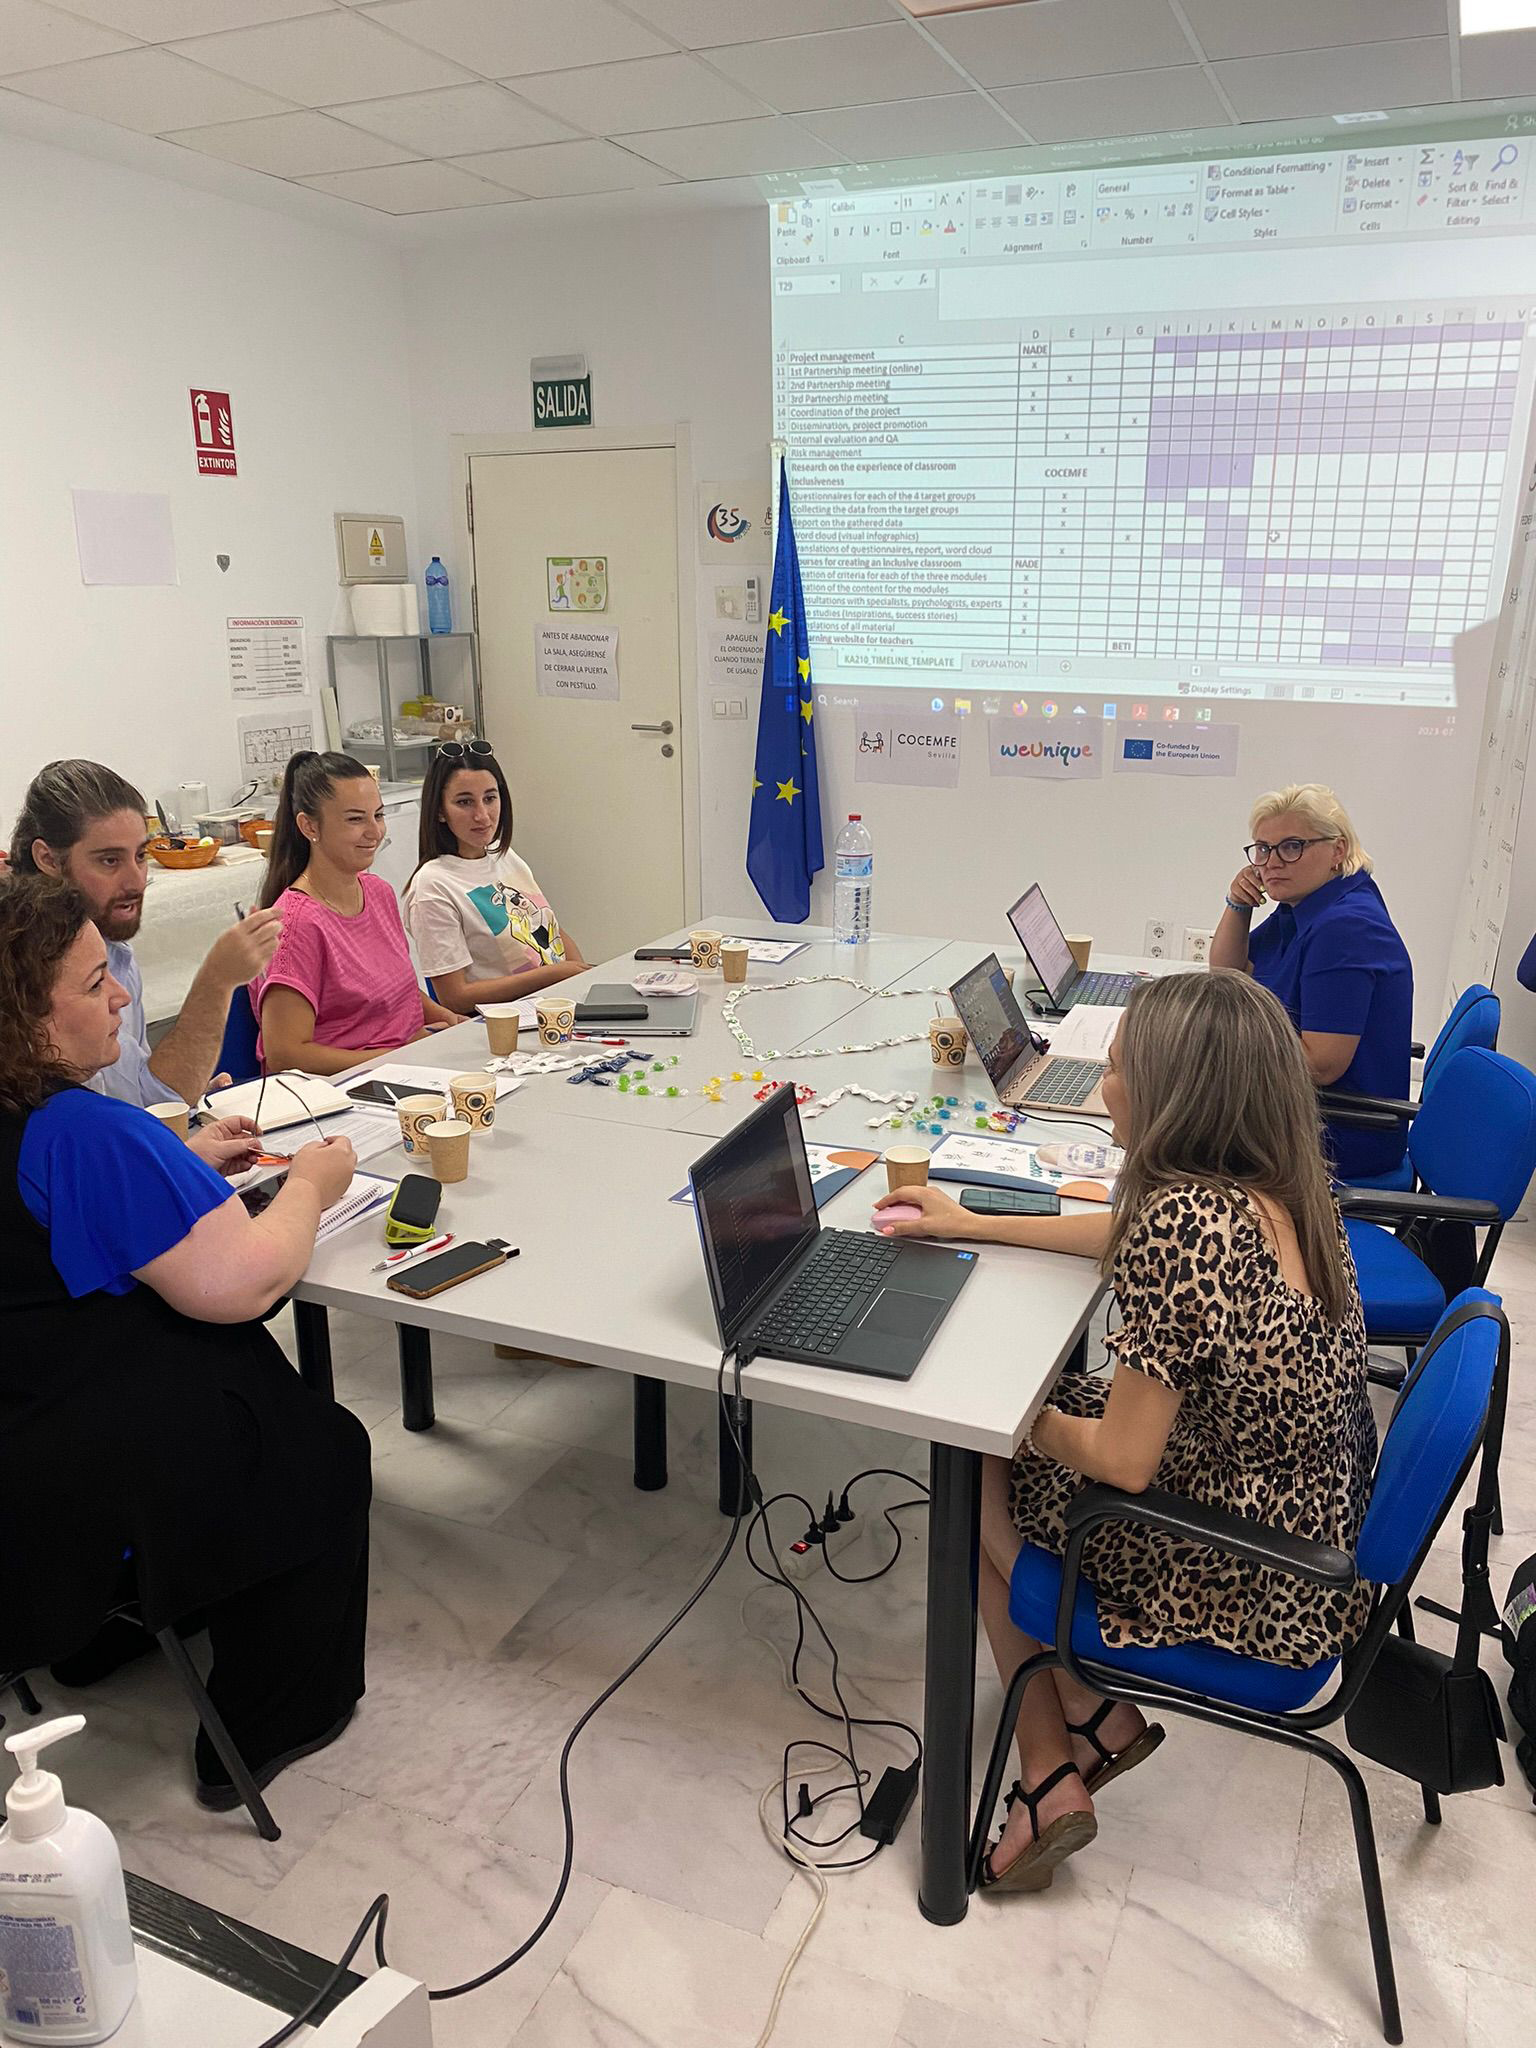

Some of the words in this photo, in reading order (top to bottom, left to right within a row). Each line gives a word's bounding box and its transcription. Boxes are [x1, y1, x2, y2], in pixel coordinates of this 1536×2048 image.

[1364, 157, 1389, 166] Insert
[1224, 165, 1274, 177] Conditional
[1276, 162, 1325, 173] Formatting
[1099, 182, 1129, 193] General
[1362, 179, 1390, 188] Delete
[1448, 182, 1466, 193] Sort
[1485, 180, 1506, 190] Find
[1222, 189, 1252, 198] Format
[1255, 188, 1264, 196] as
[1267, 185, 1288, 195] Table
[1360, 200, 1392, 210] Format
[1447, 198, 1469, 208] Filter
[1482, 195, 1510, 205] Select
[832, 202, 855, 212] Calibri
[1220, 210, 1236, 219] Cell
[1238, 208, 1263, 219] Styles
[1447, 216, 1480, 226] Editing
[1360, 222, 1380, 231] Cells
[777, 228, 796, 236] Paste
[1254, 228, 1277, 238] Styles
[1121, 236, 1153, 245] Number
[1003, 242, 1043, 252] Alignment
[883, 251, 900, 259] Font
[776, 256, 810, 266] Clipboard
[779, 282, 792, 291] T29
[1022, 345, 1048, 355] NADE
[790, 354, 818, 364] Project
[820, 352, 874, 363] management
[791, 368, 801, 376] 1st
[804, 366, 850, 376] Partnership
[853, 365, 887, 376] meeting
[889, 364, 923, 375] (online)
[791, 382, 804, 390] 2nd
[807, 380, 854, 390] Partnership
[856, 380, 890, 390] meeting
[537, 384, 588, 418] SALIDA
[806, 394, 852, 404] Partnership
[854, 394, 888, 403] meeting
[791, 408, 841, 417] Coordination
[844, 408, 853, 416] of
[871, 407, 900, 417] project
[791, 422, 851, 431] Dissemination,
[853, 421, 881, 431] project
[884, 420, 928, 430] promotion
[791, 436, 822, 444] Internal
[825, 435, 867, 443] evaluation
[886, 434, 898, 444] QA
[809, 449, 862, 458] management
[199, 458, 235, 469] EXTINTOR
[792, 463, 827, 472] Research
[841, 463, 854, 471] the
[856, 463, 902, 472] experience
[904, 462, 913, 470] of
[914, 462, 956, 470] classroom
[1045, 468, 1088, 478] COCEMFE
[792, 492, 852, 500] Questionnaires
[854, 492, 866, 500] for
[868, 492, 886, 500] each
[888, 492, 897, 500] of
[899, 492, 912, 500] the
[914, 492, 919, 500] 4
[921, 492, 945, 502] target
[947, 493, 975, 502] groups
[792, 505, 831, 514] Collecting
[833, 505, 846, 513] the
[848, 505, 866, 513] data
[868, 505, 887, 513] from
[889, 505, 902, 513] the
[904, 506, 929, 516] target
[931, 506, 959, 516] groups
[832, 519, 845, 527] the
[847, 519, 883, 529] gathered
[885, 519, 903, 527] data
[815, 532, 837, 540] cloud
[839, 532, 865, 541] (visual
[866, 532, 919, 542] infographics)
[797, 545, 839, 553] ranslations
[841, 545, 850, 553] of
[851, 545, 913, 555] questionnaires,
[915, 547, 943, 555] report,
[945, 546, 967, 554] word
[969, 546, 992, 554] cloud
[825, 558, 836, 566] for
[838, 558, 870, 568] creating
[920, 559, 961, 568] classroom
[1015, 559, 1039, 569] NADE
[847, 597, 865, 605] with
[867, 598, 910, 607] specialists,
[912, 599, 968, 608] psychologists,
[971, 600, 1002, 608] experts
[927, 611, 957, 621] stories)
[862, 623, 895, 631] material
[570, 634, 609, 642] ABANDONAR
[726, 634, 758, 642] APAGUEN
[834, 635, 865, 643] website
[866, 636, 878, 644] for
[880, 636, 914, 644] teachers
[844, 655, 954, 667] KA210_TIMELINE_TEMPLATE
[971, 660, 1027, 669] EXPLANATION
[1191, 685, 1218, 694] Display
[1220, 686, 1252, 695] Settings
[898, 733, 957, 748] COCEMFE
[1156, 742, 1188, 750] Co-funded
[1191, 743, 1200, 751] by
[1001, 742, 1092, 766] weUnique
[1168, 752, 1198, 760] European
